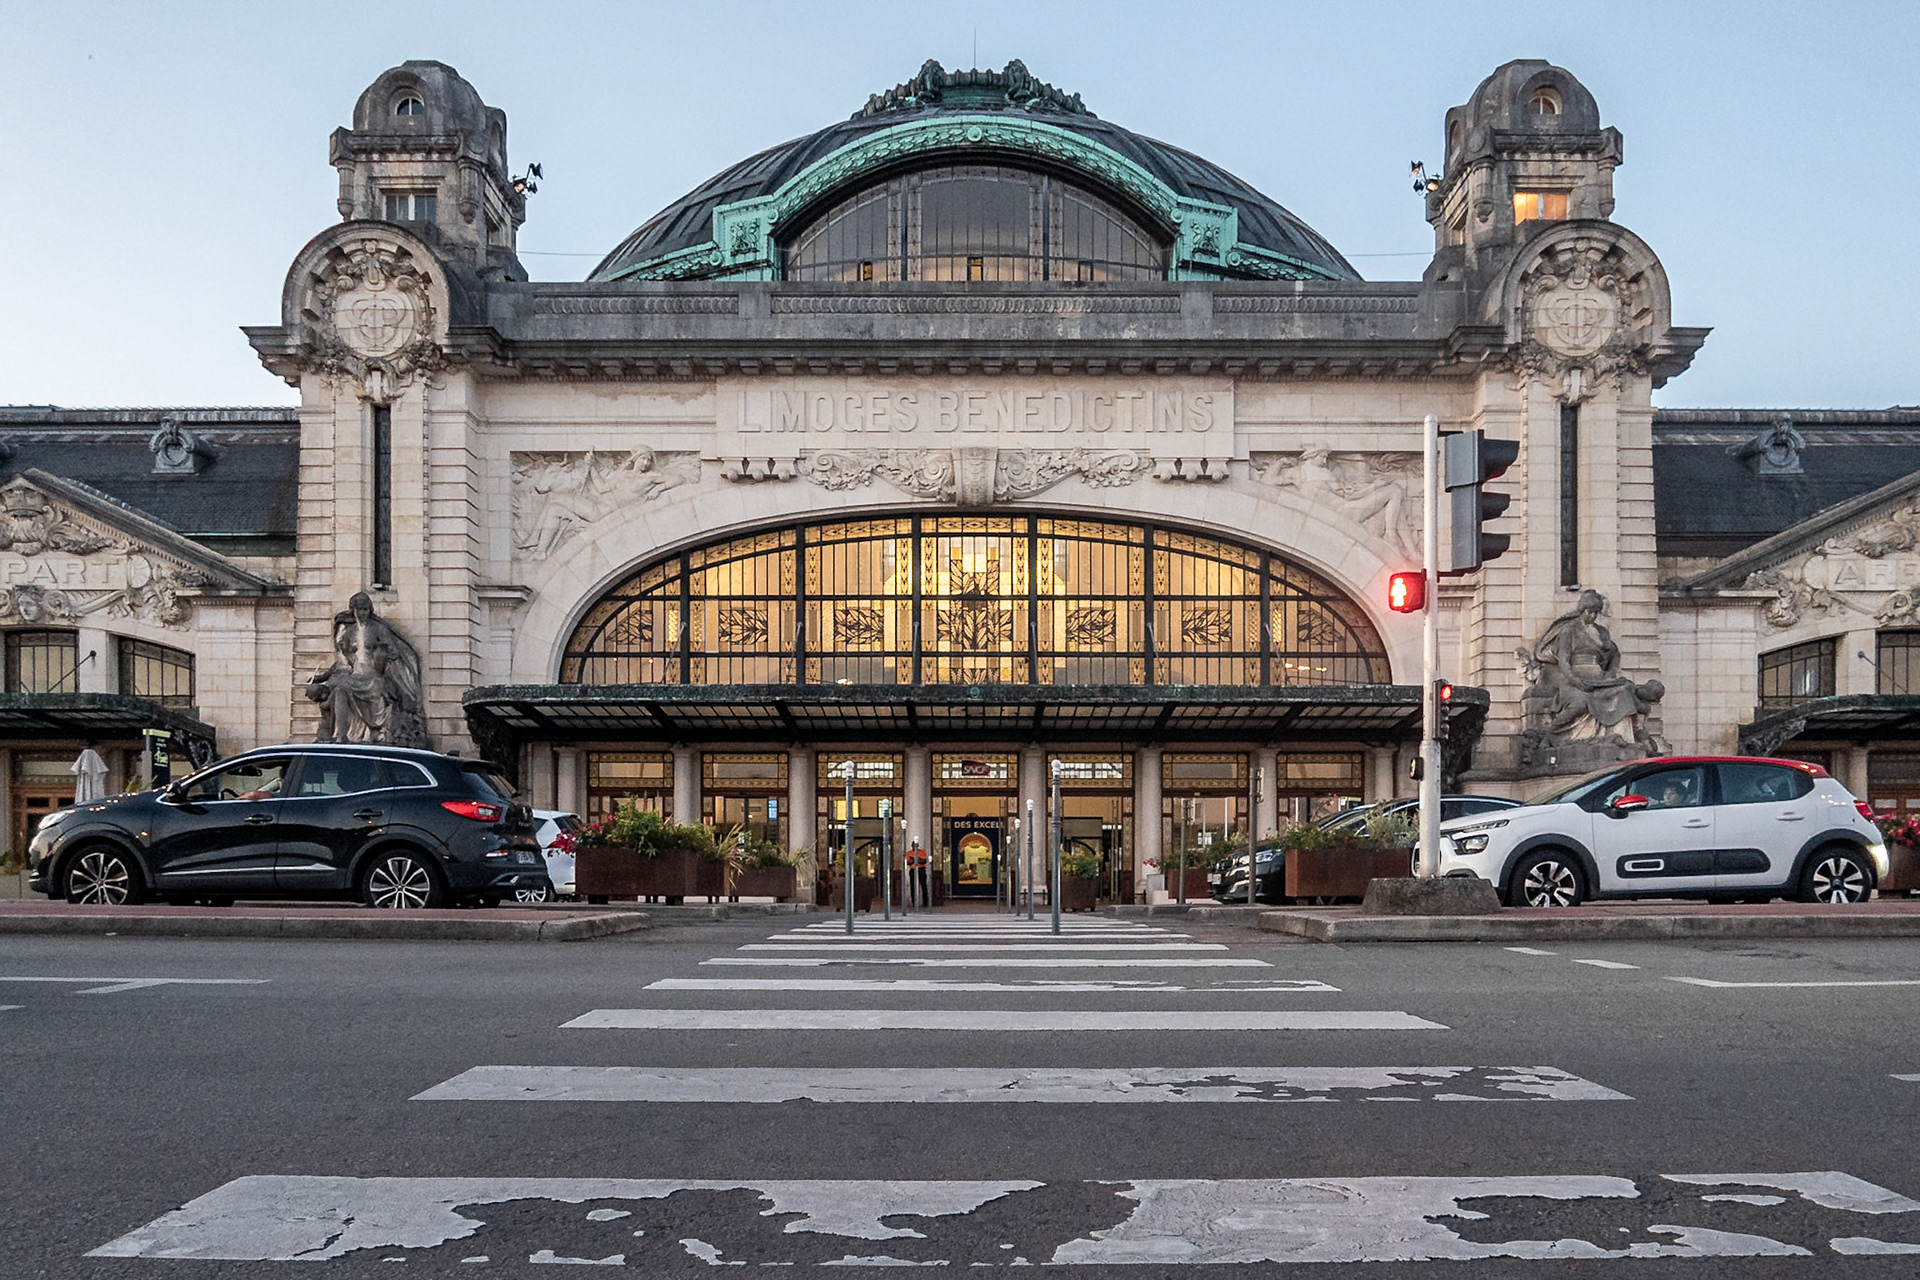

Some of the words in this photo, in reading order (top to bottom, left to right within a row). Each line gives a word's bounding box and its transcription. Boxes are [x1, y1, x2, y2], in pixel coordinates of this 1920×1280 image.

[737, 390, 919, 433] LIMOGES
[934, 390, 1214, 433] BENEDICTINS
[962, 765, 989, 775] SNCF
[954, 821, 972, 829] DES
